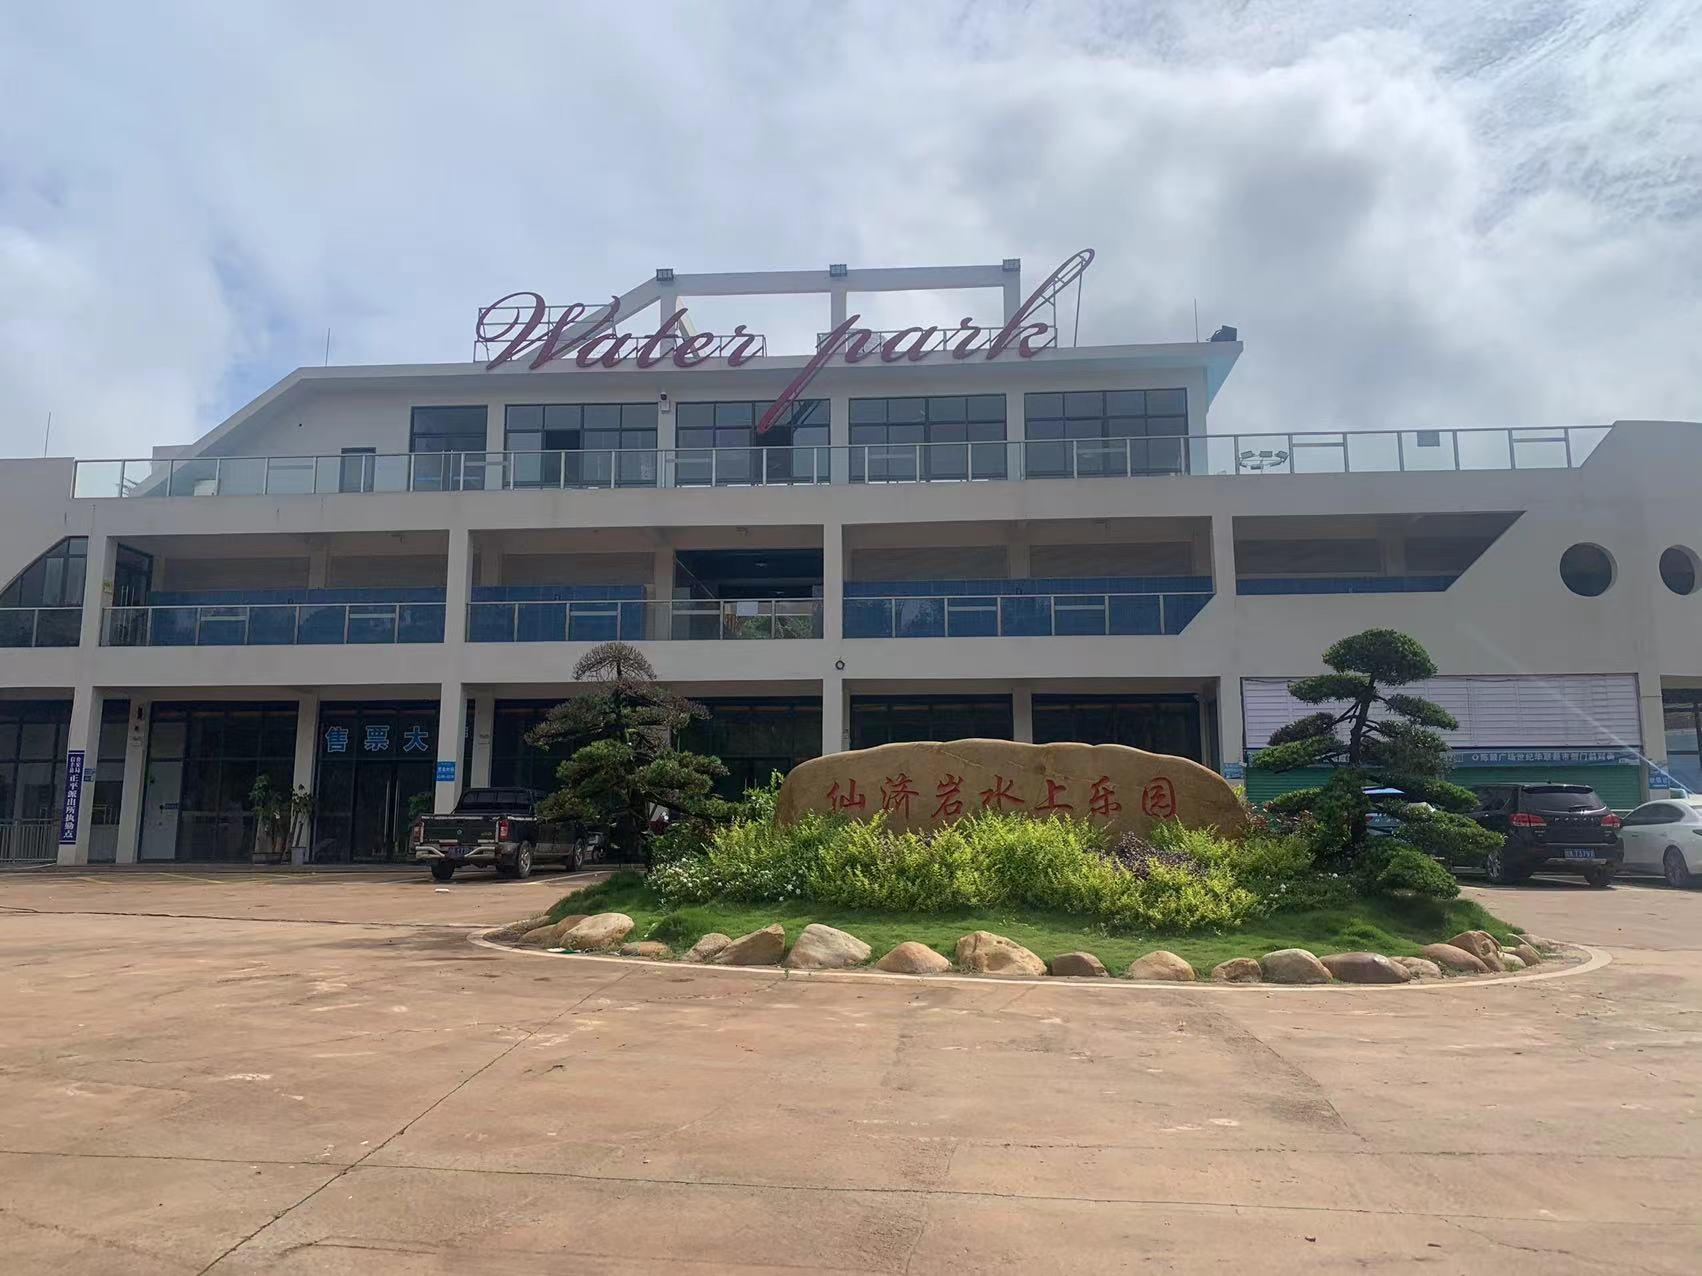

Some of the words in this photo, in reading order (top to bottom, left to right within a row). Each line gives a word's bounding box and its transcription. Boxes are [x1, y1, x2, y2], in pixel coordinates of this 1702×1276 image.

[476, 292, 764, 371] Water
[757, 248, 1096, 434] park
[325, 725, 468, 753] 售票大
[827, 772, 1177, 819] 仙济岩水上乐园
